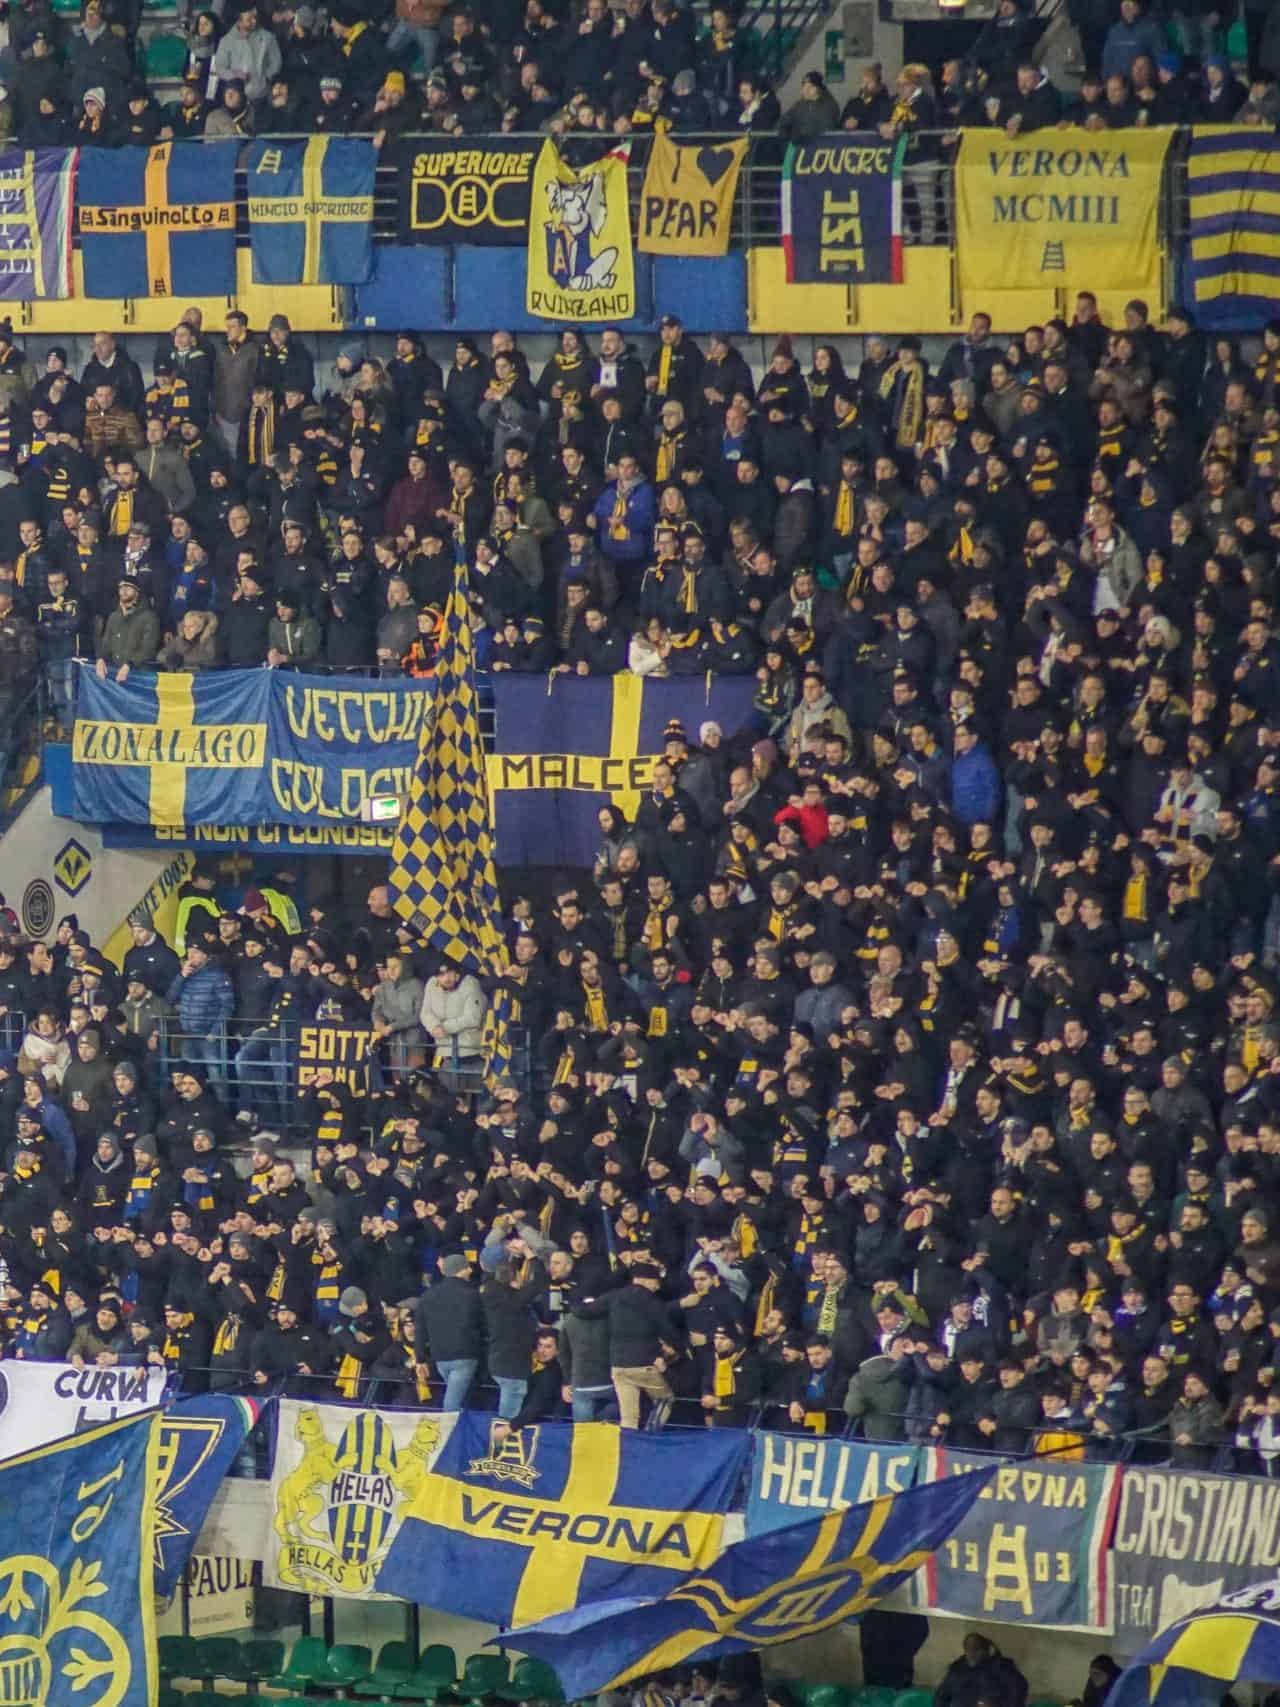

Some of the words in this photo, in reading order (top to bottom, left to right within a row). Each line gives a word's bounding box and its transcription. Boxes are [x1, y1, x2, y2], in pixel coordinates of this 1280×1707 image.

[412, 149, 534, 177] SUPERIORE
[988, 149, 1130, 178] VERONA
[96, 207, 214, 230] Sanguinotto
[410, 174, 529, 229] DOC
[645, 196, 720, 239] PEAR
[992, 194, 1120, 225] MCMIII
[80, 723, 257, 764] ZONALAGO
[195, 824, 249, 842] NON
[288, 825, 396, 847] CONOSC
[54, 1369, 148, 1403] CURVA
[330, 1471, 394, 1508] HELLAS
[759, 1435, 911, 1513] HELLAS
[460, 1494, 691, 1559] VERONA
[288, 1547, 347, 1584] HELLAS
